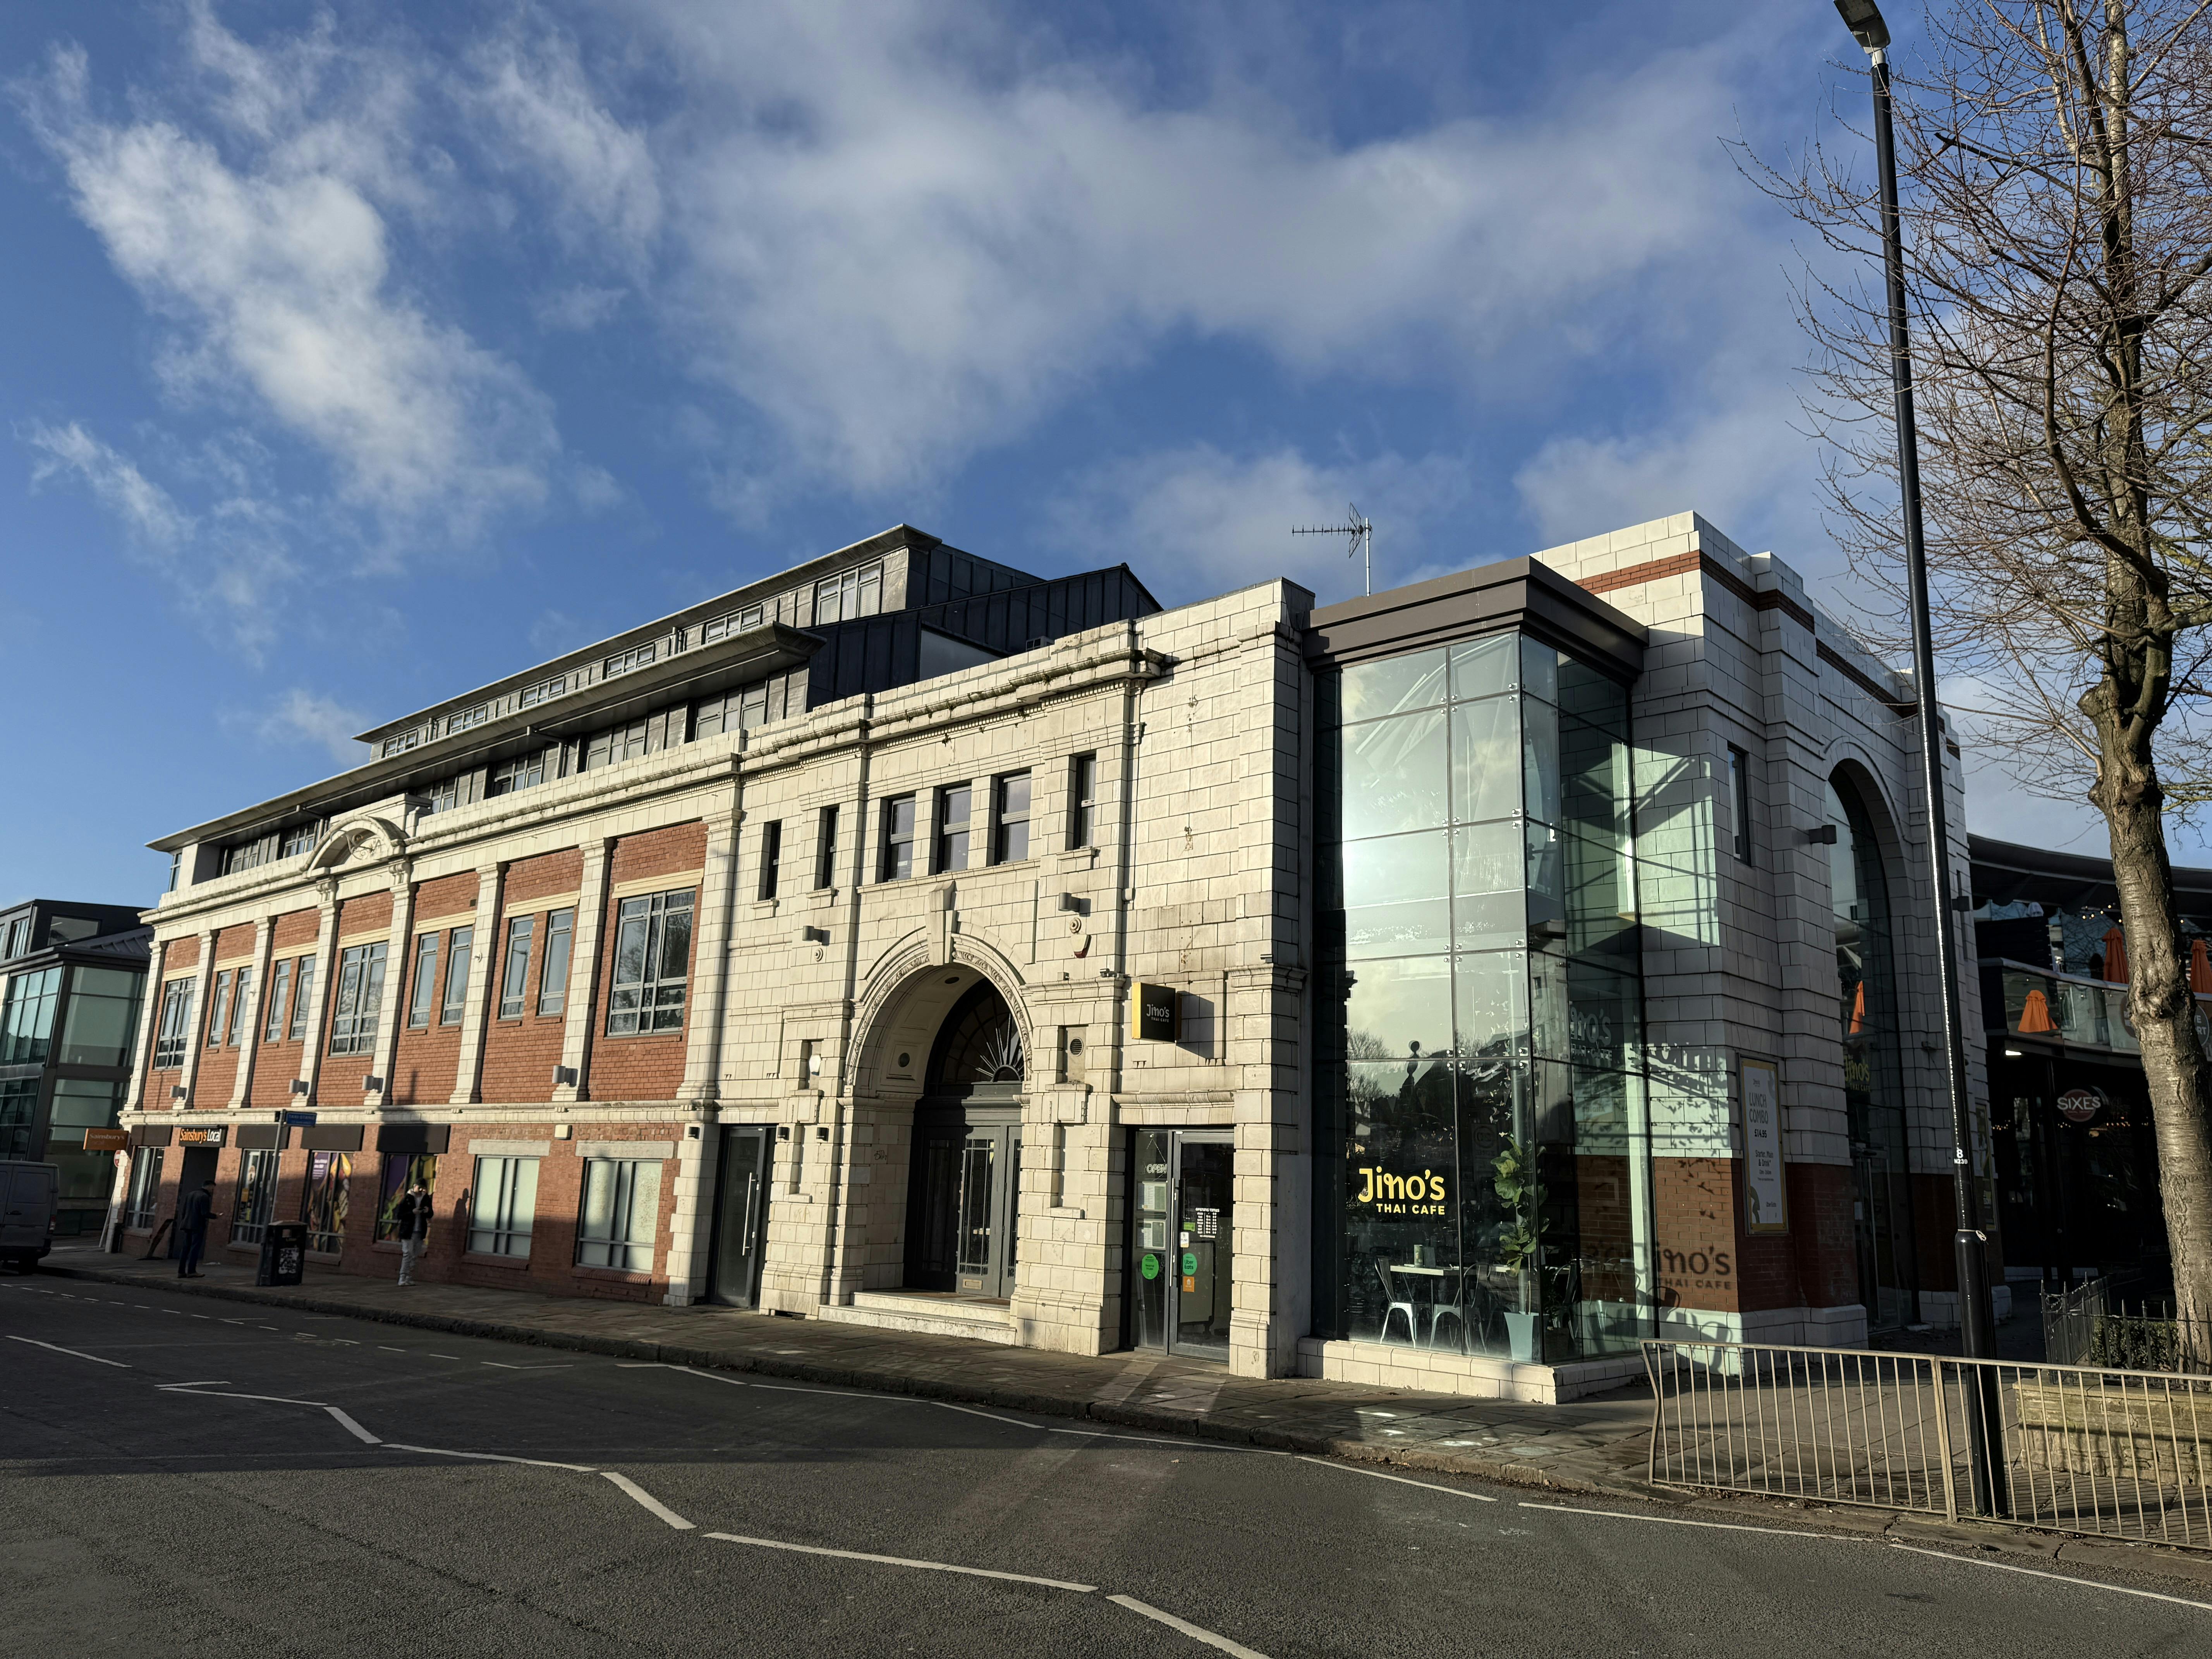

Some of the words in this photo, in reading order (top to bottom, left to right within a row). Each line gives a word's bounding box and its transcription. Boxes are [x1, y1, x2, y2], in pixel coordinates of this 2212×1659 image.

[1749, 1092, 1767, 1108] LUNCH
[2057, 1096, 2101, 1110] SIXES
[1749, 1108, 1769, 1124] COMBO
[180, 1128, 208, 1144] Sainsbury's
[207, 1128, 222, 1142] Local
[1755, 1129, 1767, 1138] £14.95
[1956, 1149, 1963, 1158] 8
[1146, 1163, 1167, 1173] OPEN
[1376, 1204, 1406, 1214] THAI
[1412, 1205, 1445, 1215] CAFE
